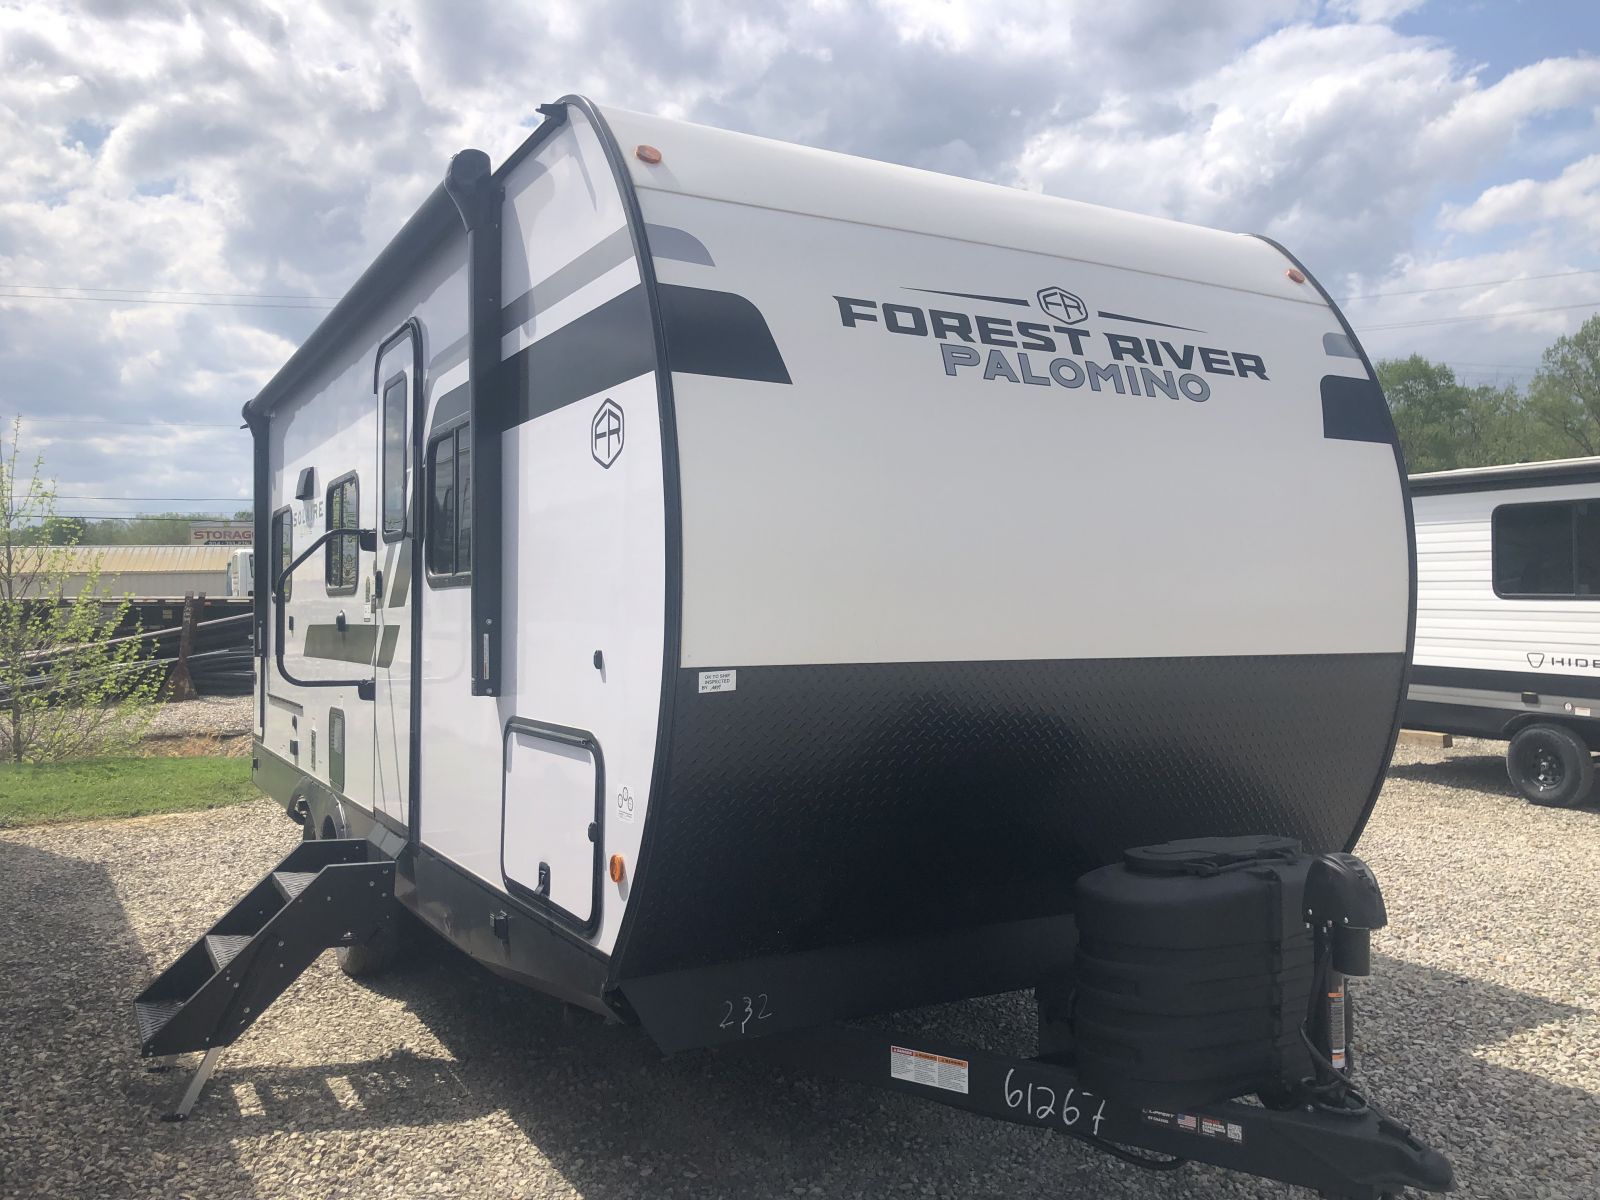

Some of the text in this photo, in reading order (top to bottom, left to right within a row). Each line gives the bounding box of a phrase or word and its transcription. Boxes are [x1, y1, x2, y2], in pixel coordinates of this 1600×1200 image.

[832, 296, 1270, 380] FOREST RIVER
[940, 343, 1210, 402] PALOMINO
[193, 530, 254, 540] STORAG
[719, 993, 773, 1034] 232
[1004, 1068, 1105, 1135] 61267
